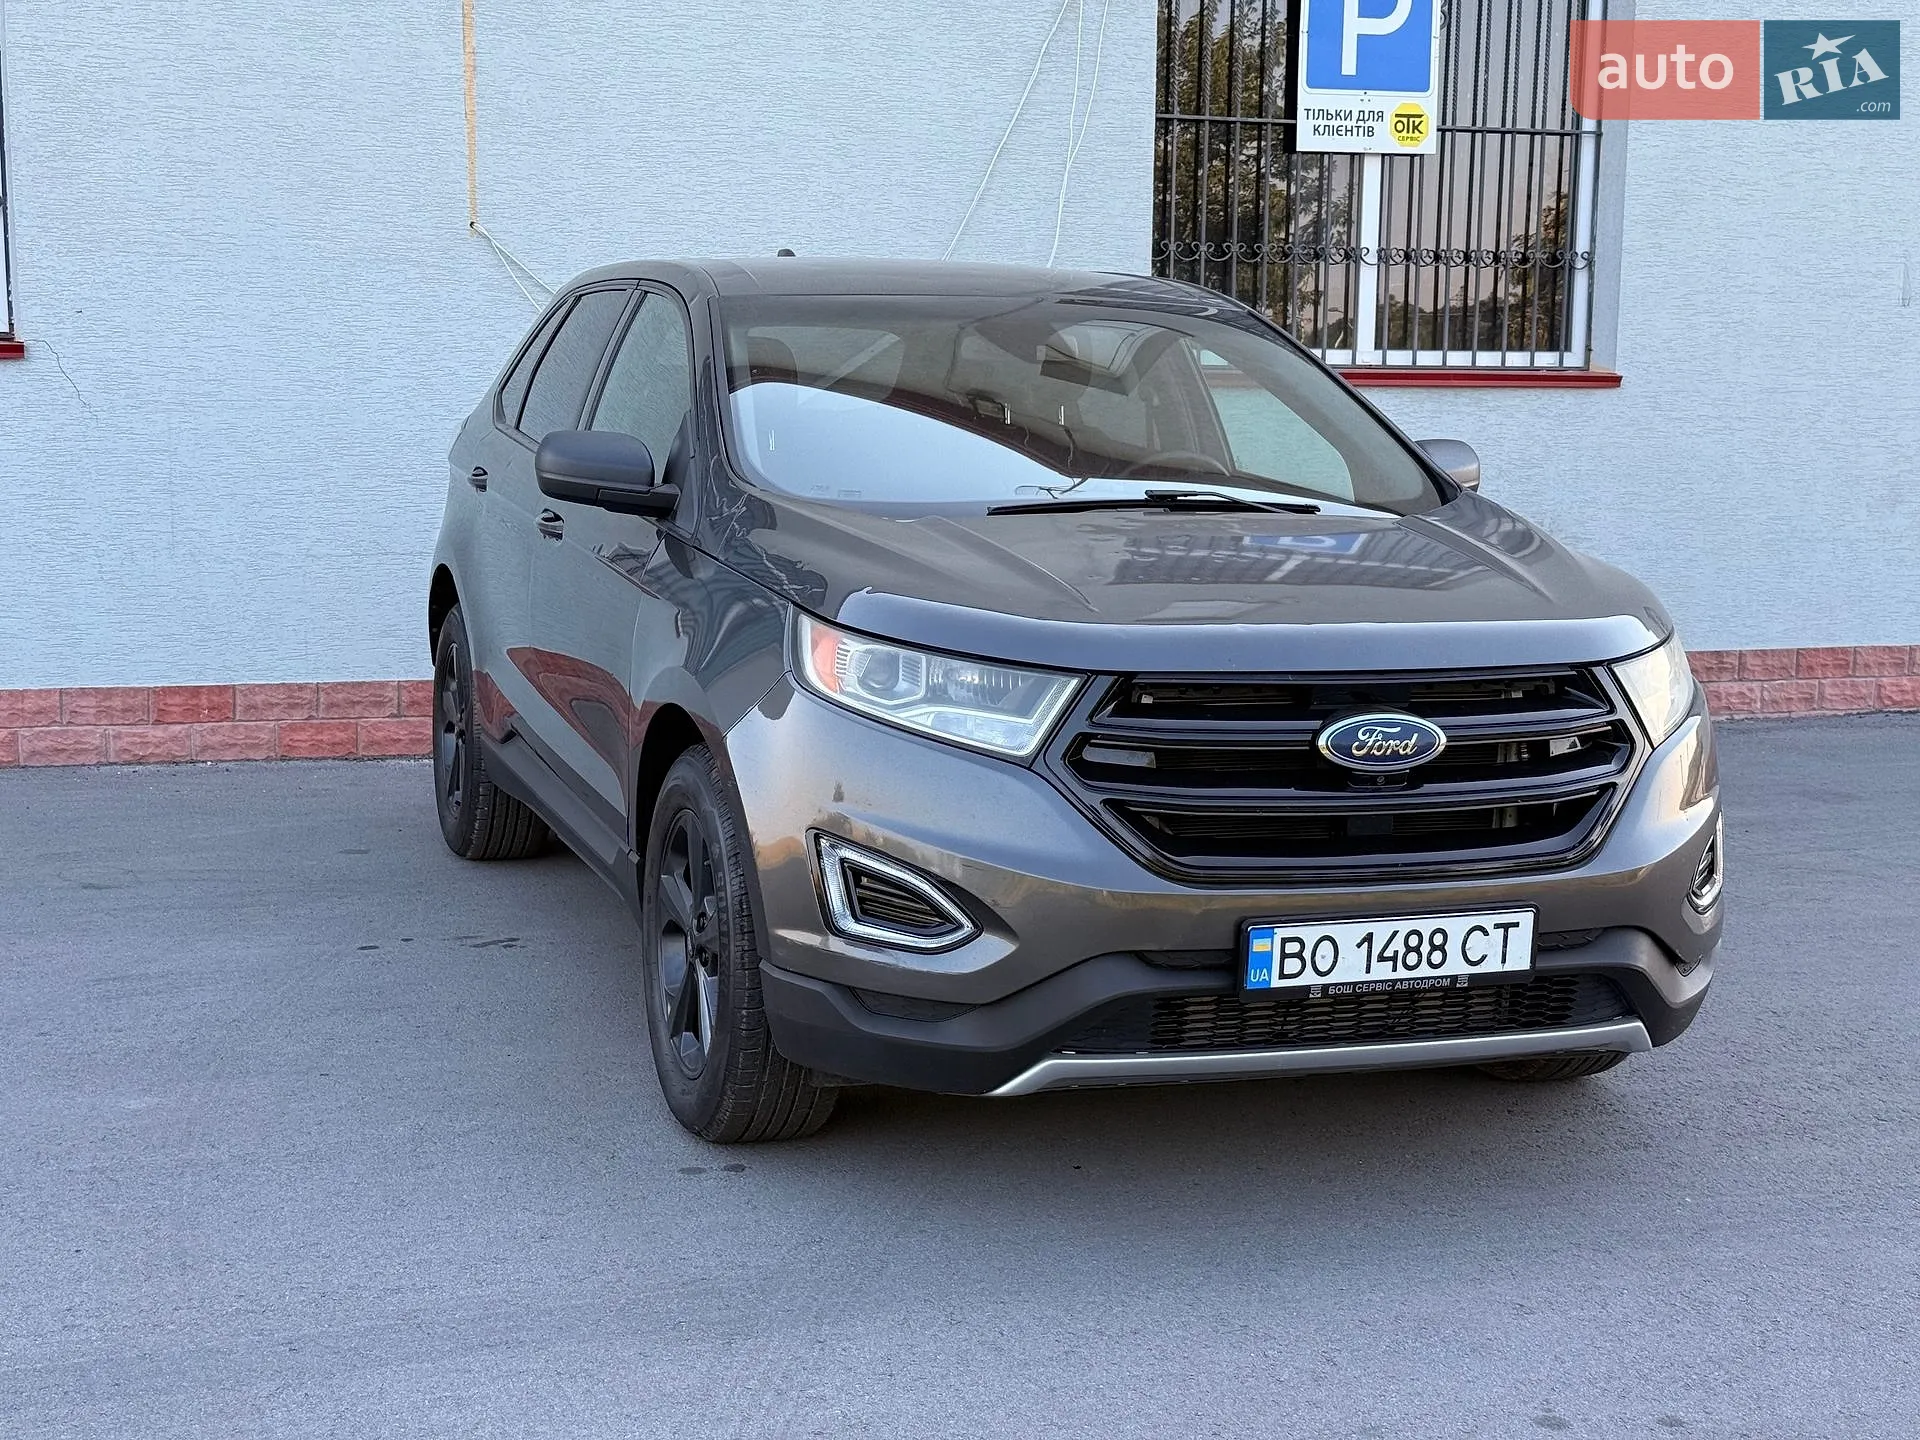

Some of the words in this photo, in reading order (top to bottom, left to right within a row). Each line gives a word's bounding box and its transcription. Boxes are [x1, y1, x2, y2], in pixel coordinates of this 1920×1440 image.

[1340, 0, 1413, 76] P
[1303, 108, 1353, 121] ТІЛЬКИ
[1356, 110, 1384, 124] ДЛЯ
[1312, 124, 1375, 137] КЛІЄНТІВ
[1351, 726, 1418, 757] Ford
[1278, 935, 1340, 980] BO
[1355, 927, 1449, 974] 1488
[1460, 921, 1520, 967] CT
[1250, 967, 1270, 982] UA
[1328, 985, 1353, 995] БОШ
[1355, 981, 1393, 993] СЕРВІС
[1394, 978, 1451, 991] АВТОДРОМ
